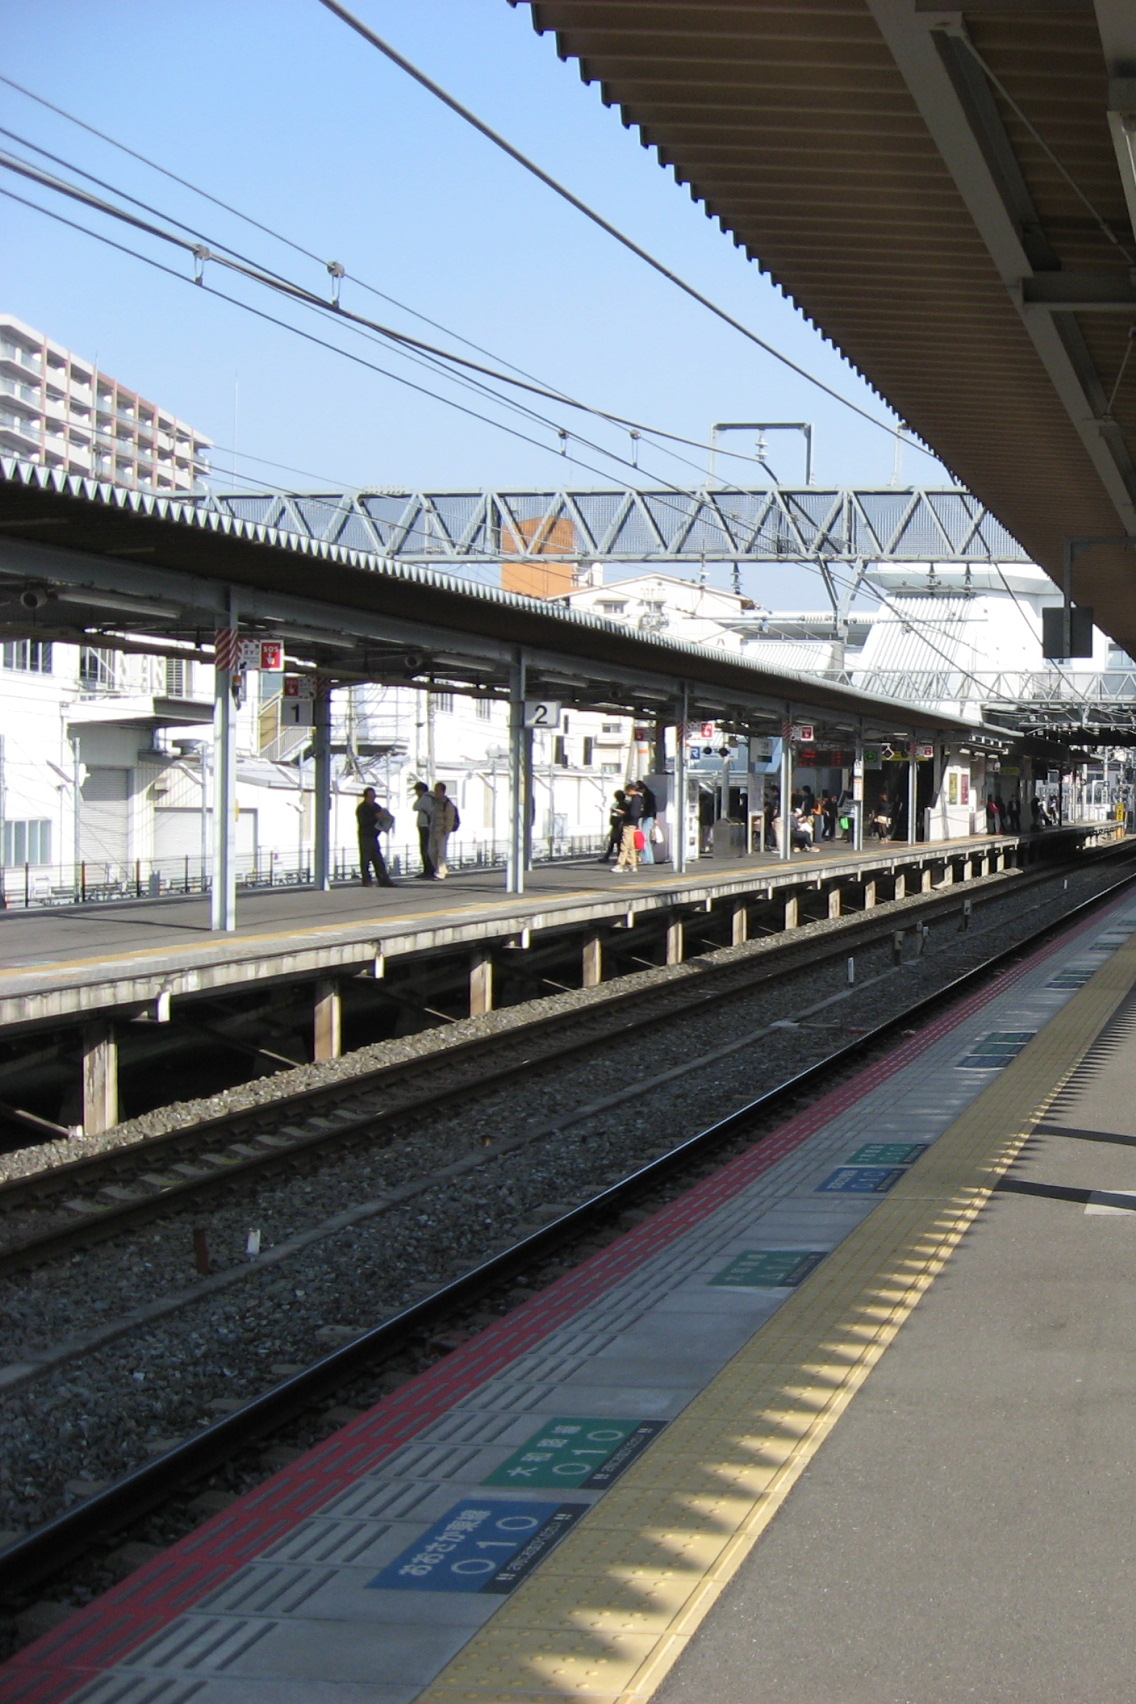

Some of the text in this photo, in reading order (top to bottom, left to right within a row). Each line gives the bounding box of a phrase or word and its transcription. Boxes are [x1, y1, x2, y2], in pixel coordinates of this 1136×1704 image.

[263, 645, 279, 653] SOS
[290, 703, 300, 723] 1
[534, 704, 548, 725] 2
[398, 1509, 492, 1576] おおさか東線
